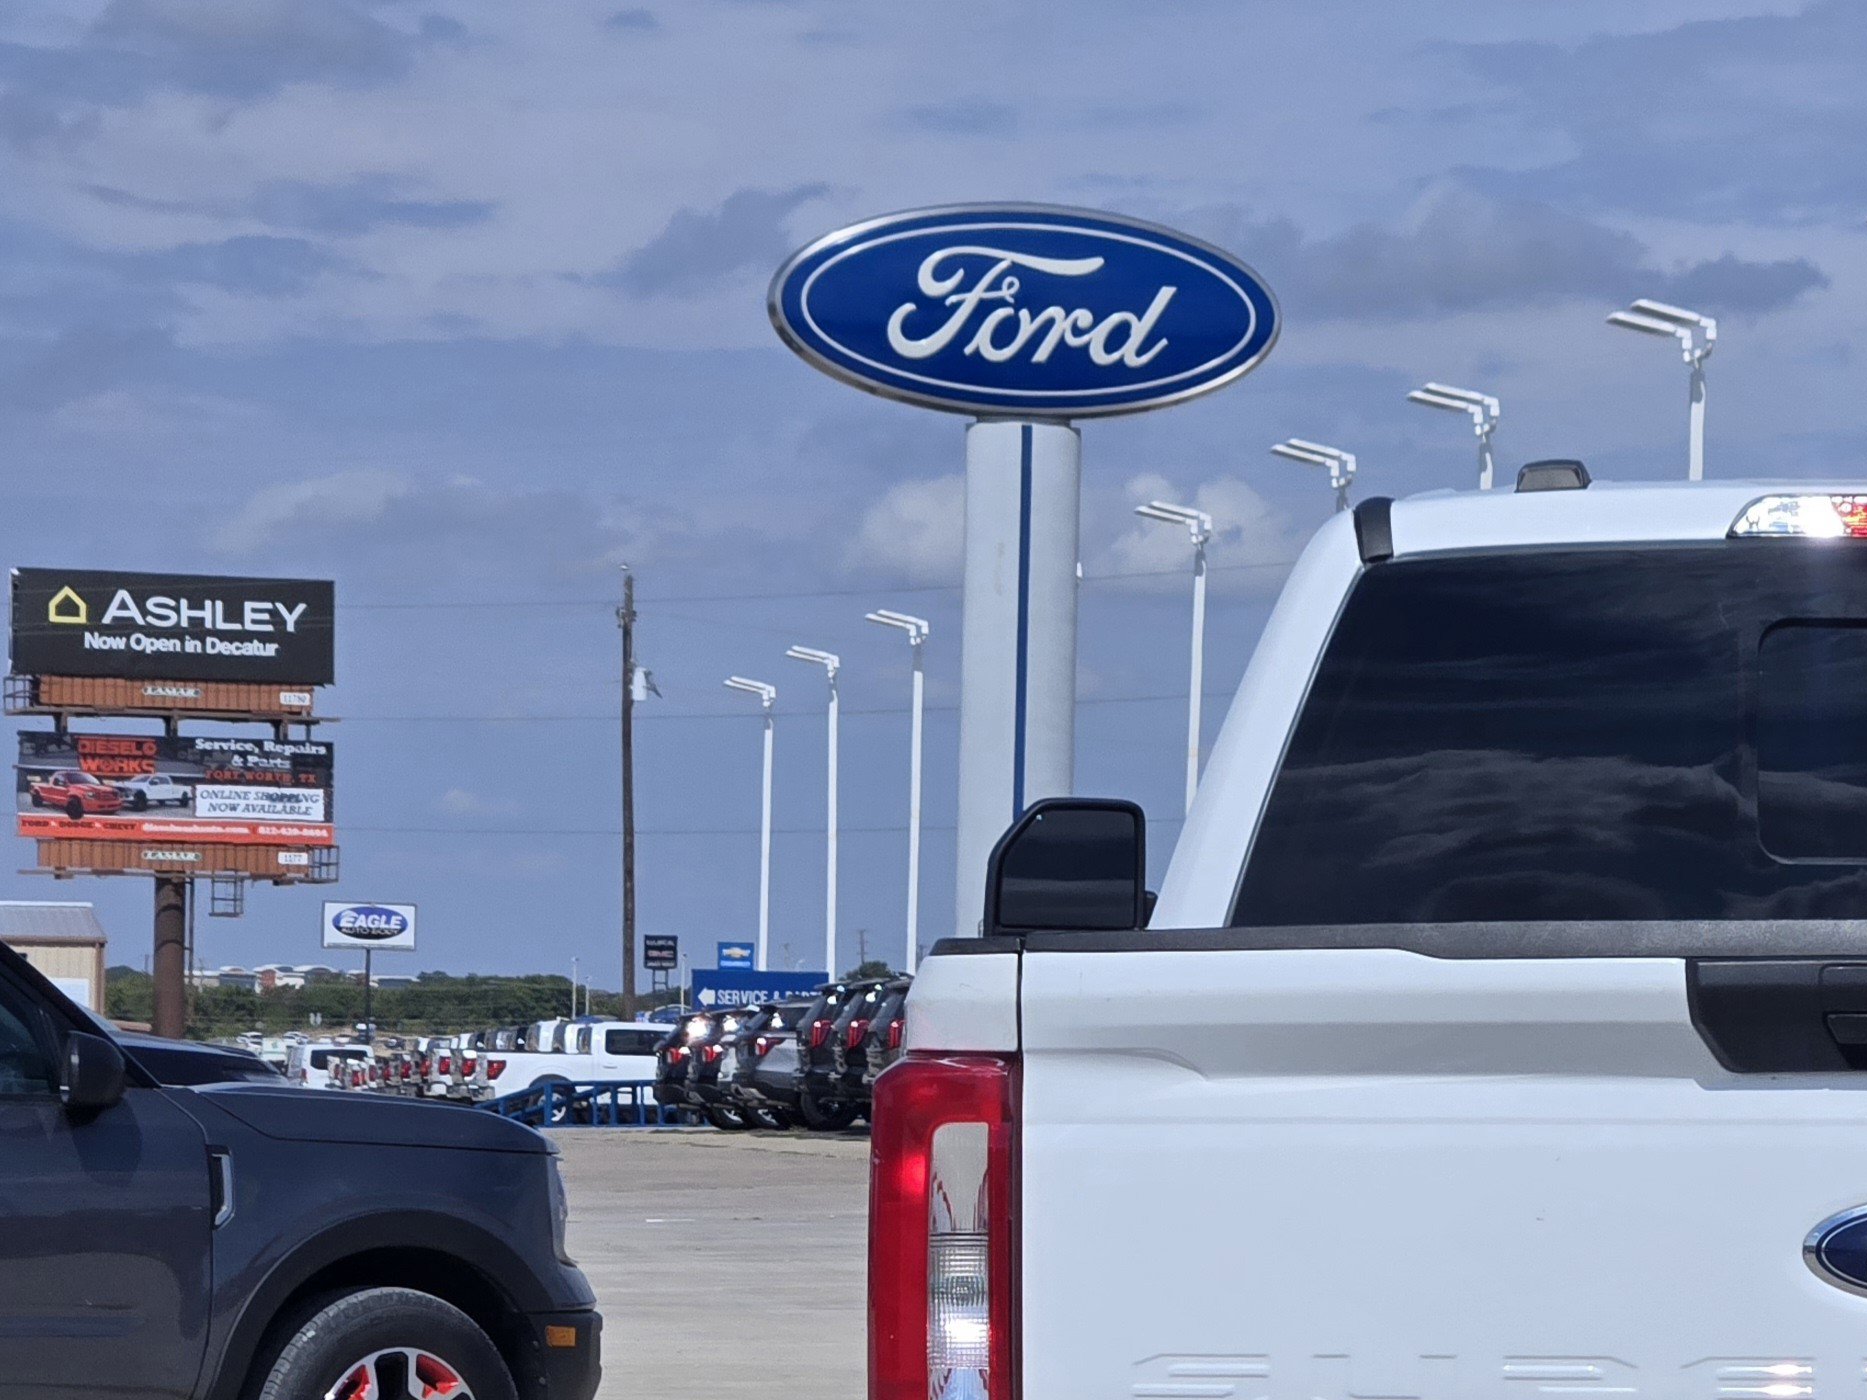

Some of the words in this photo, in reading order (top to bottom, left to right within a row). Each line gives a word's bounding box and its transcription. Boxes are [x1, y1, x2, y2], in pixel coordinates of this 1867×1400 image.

[887, 244, 1178, 368] Ford
[101, 588, 308, 633] ASHLEY
[84, 631, 127, 651] Now
[129, 632, 182, 655] Open
[184, 635, 202, 653] in
[205, 636, 281, 657] Decatur
[195, 738, 260, 754] Service,
[263, 740, 327, 756] Repairs
[82, 757, 156, 775] WORKS
[246, 755, 291, 769] Parts
[200, 789, 252, 801] ONLINE
[254, 791, 321, 804] SHOPPING
[208, 802, 241, 813] NOW
[241, 803, 313, 816] AVAILABLE
[340, 909, 403, 929] EAGLE
[717, 989, 769, 1005] SERVICE
